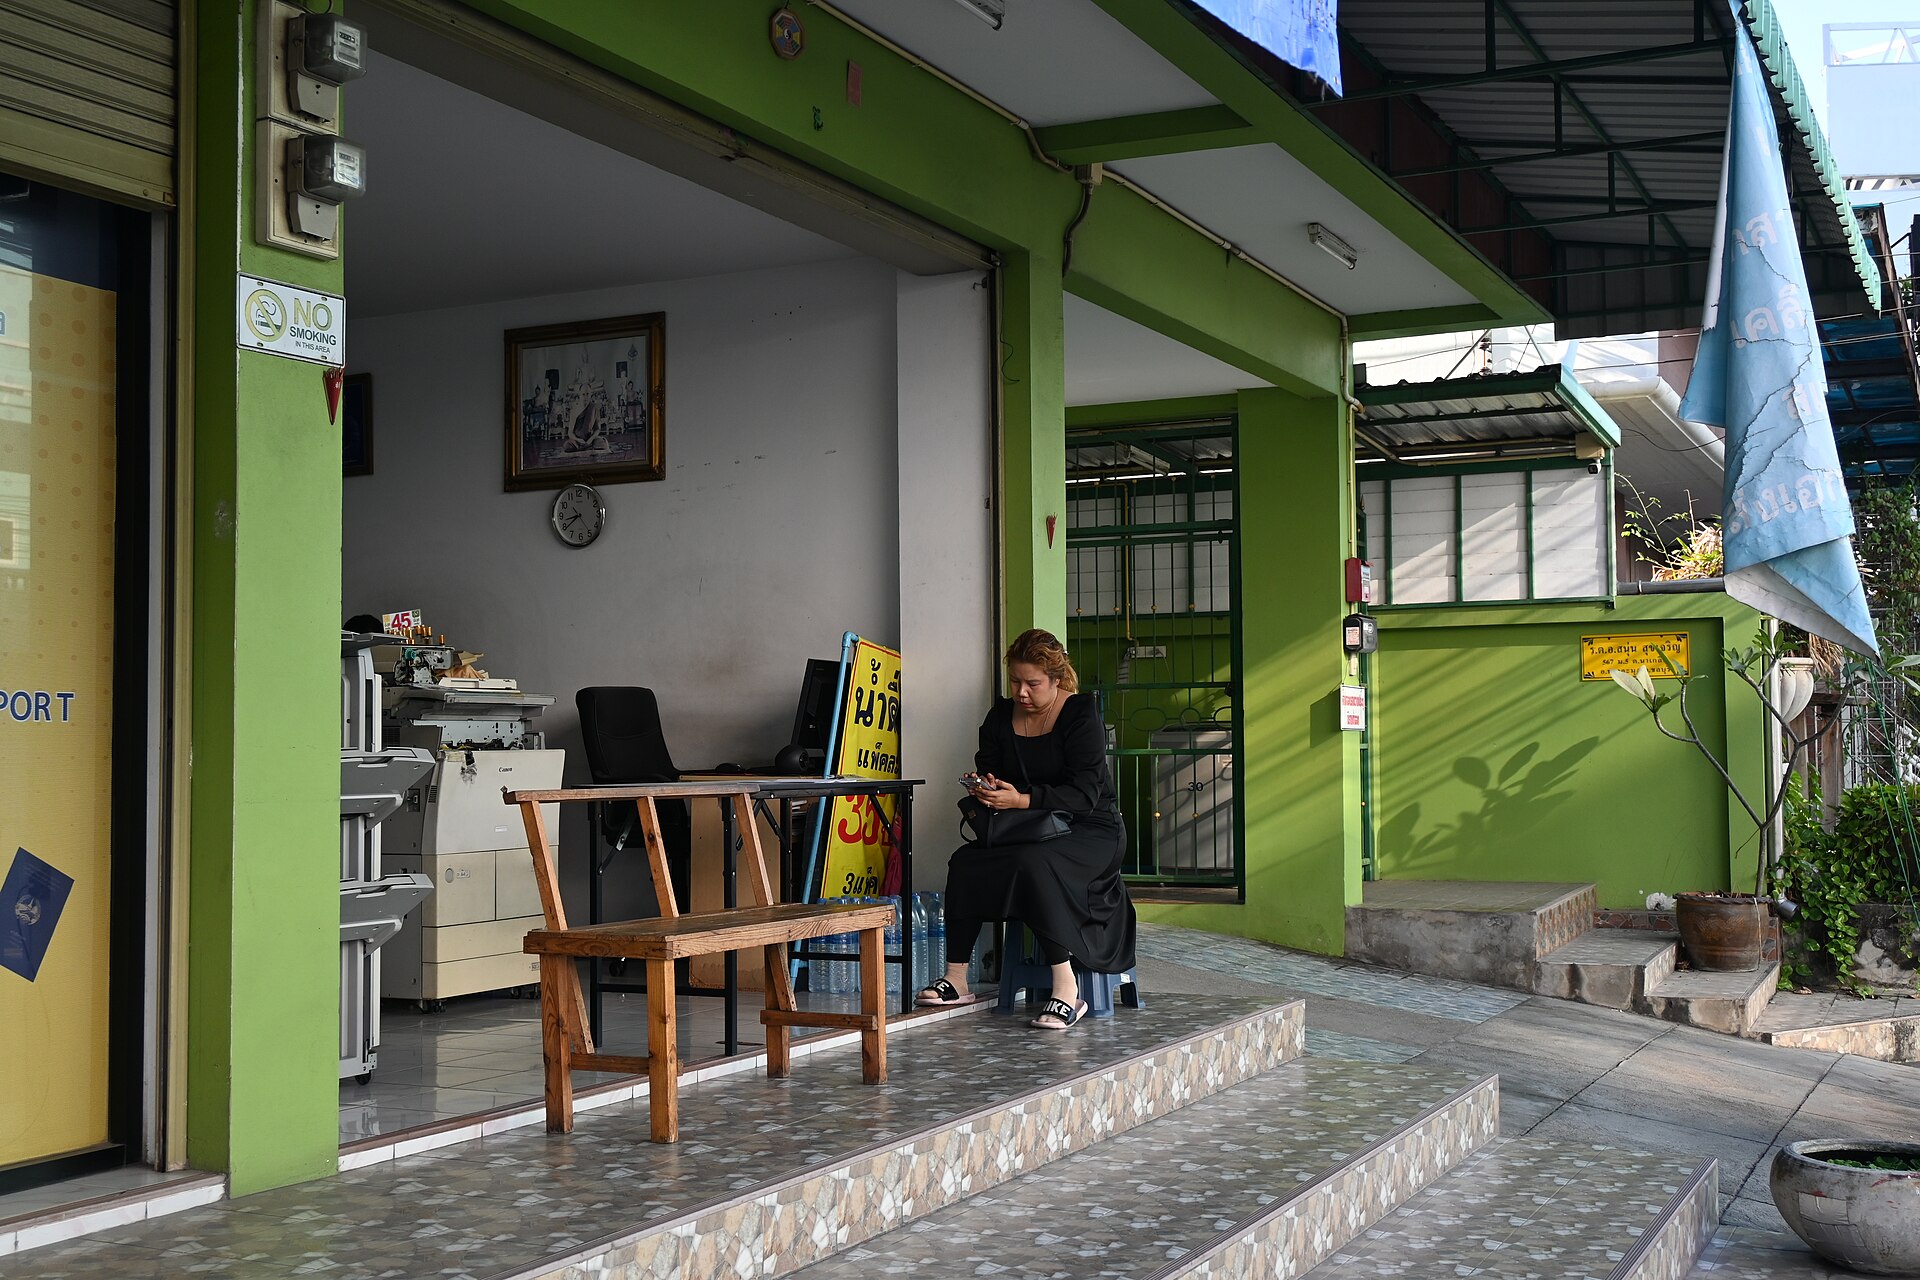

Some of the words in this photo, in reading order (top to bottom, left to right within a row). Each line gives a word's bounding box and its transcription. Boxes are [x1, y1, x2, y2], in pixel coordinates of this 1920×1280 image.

[294, 297, 332, 331] NO
[290, 326, 336, 346] SMOKING
[302, 341, 315, 351] THIS
[315, 345, 331, 354] AREA
[560, 501, 567, 509] 10
[391, 612, 412, 629] 45
